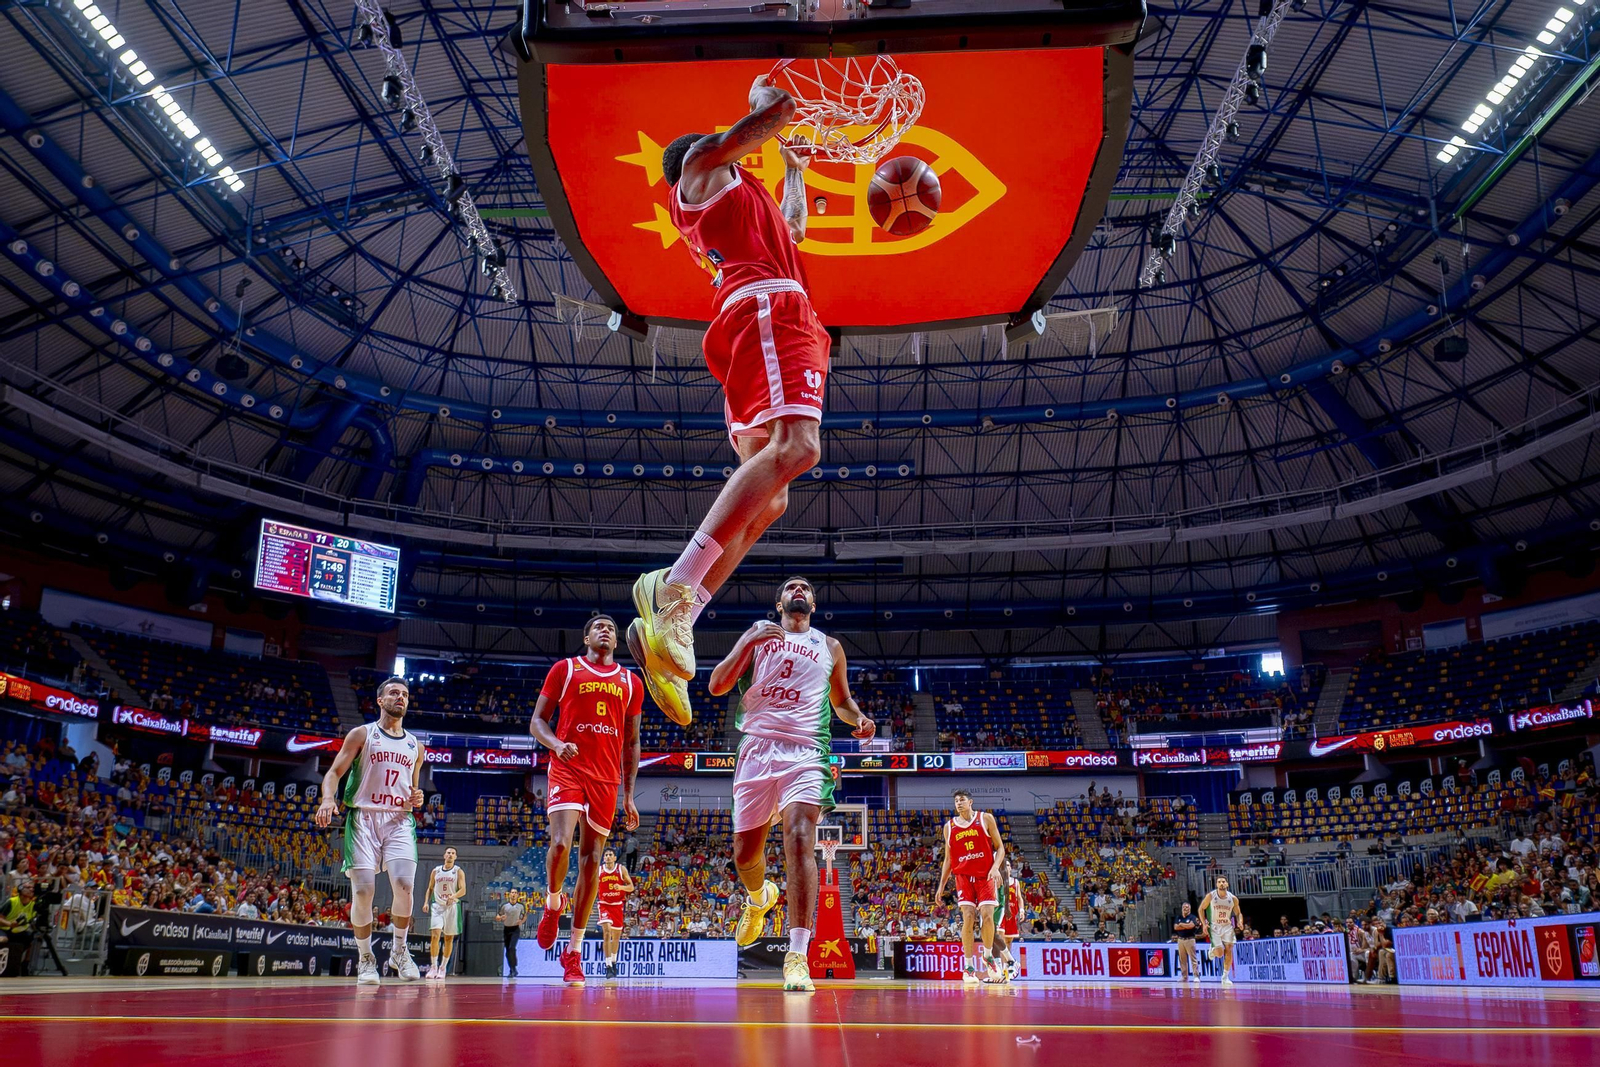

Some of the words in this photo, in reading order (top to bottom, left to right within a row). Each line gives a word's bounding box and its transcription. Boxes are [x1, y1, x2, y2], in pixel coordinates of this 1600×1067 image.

[316, 534, 327, 544] 11
[337, 539, 349, 549] 20
[321, 561, 343, 573] 1:49
[764, 641, 820, 663] PORTUGAL
[780, 659, 793, 679] 3
[579, 682, 623, 700] ESPAÑA
[761, 685, 801, 702] una
[46, 695, 99, 718] endesa
[596, 701, 606, 716] 8
[1532, 705, 1586, 724] CaixaBank
[133, 713, 182, 733] CaixaBank
[1434, 722, 1492, 741] endesa
[487, 753, 531, 765] CaixaBank
[705, 757, 735, 767] ESPAÑ
[891, 755, 908, 768] 23
[924, 756, 944, 768] 20
[968, 757, 1019, 766] PORTUGAL
[1066, 754, 1117, 766] endesa
[1153, 751, 1200, 764] CaixaBank
[385, 769, 399, 787] 17
[371, 793, 404, 807] una
[955, 829, 979, 841] ESPAÑA
[964, 841, 975, 851] 16
[959, 852, 984, 862] endesa
[153, 922, 189, 938] endesa
[204, 928, 229, 940] CaixaBank
[286, 932, 309, 945] endesa
[1396, 932, 1430, 956] ENTRADAS
[1432, 932, 1439, 956] A
[1440, 931, 1449, 955] LA
[659, 941, 697, 962] ARENA
[1236, 942, 1254, 965] MADRID
[1254, 940, 1280, 964] MOVISTAR
[1280, 939, 1299, 963] ARENA
[1301, 937, 1326, 958] ENTRADAS
[1327, 936, 1333, 957] A
[1333, 935, 1342, 957] LA
[1474, 919, 1536, 978] ESPAÑA
[813, 960, 847, 968] CaixaBank
[1043, 942, 1104, 975] ESPAÑA
[272, 960, 302, 972] #LaFamilia
[585, 963, 594, 975] DE
[597, 963, 626, 975] AGTO
[633, 963, 656, 975] 20:00
[657, 963, 665, 975] H.
[1302, 959, 1319, 980] VENTA
[1319, 959, 1327, 980] EN
[1400, 957, 1420, 980] VENTA
[1421, 957, 1431, 980] EN
[1582, 962, 1598, 973] DBB
